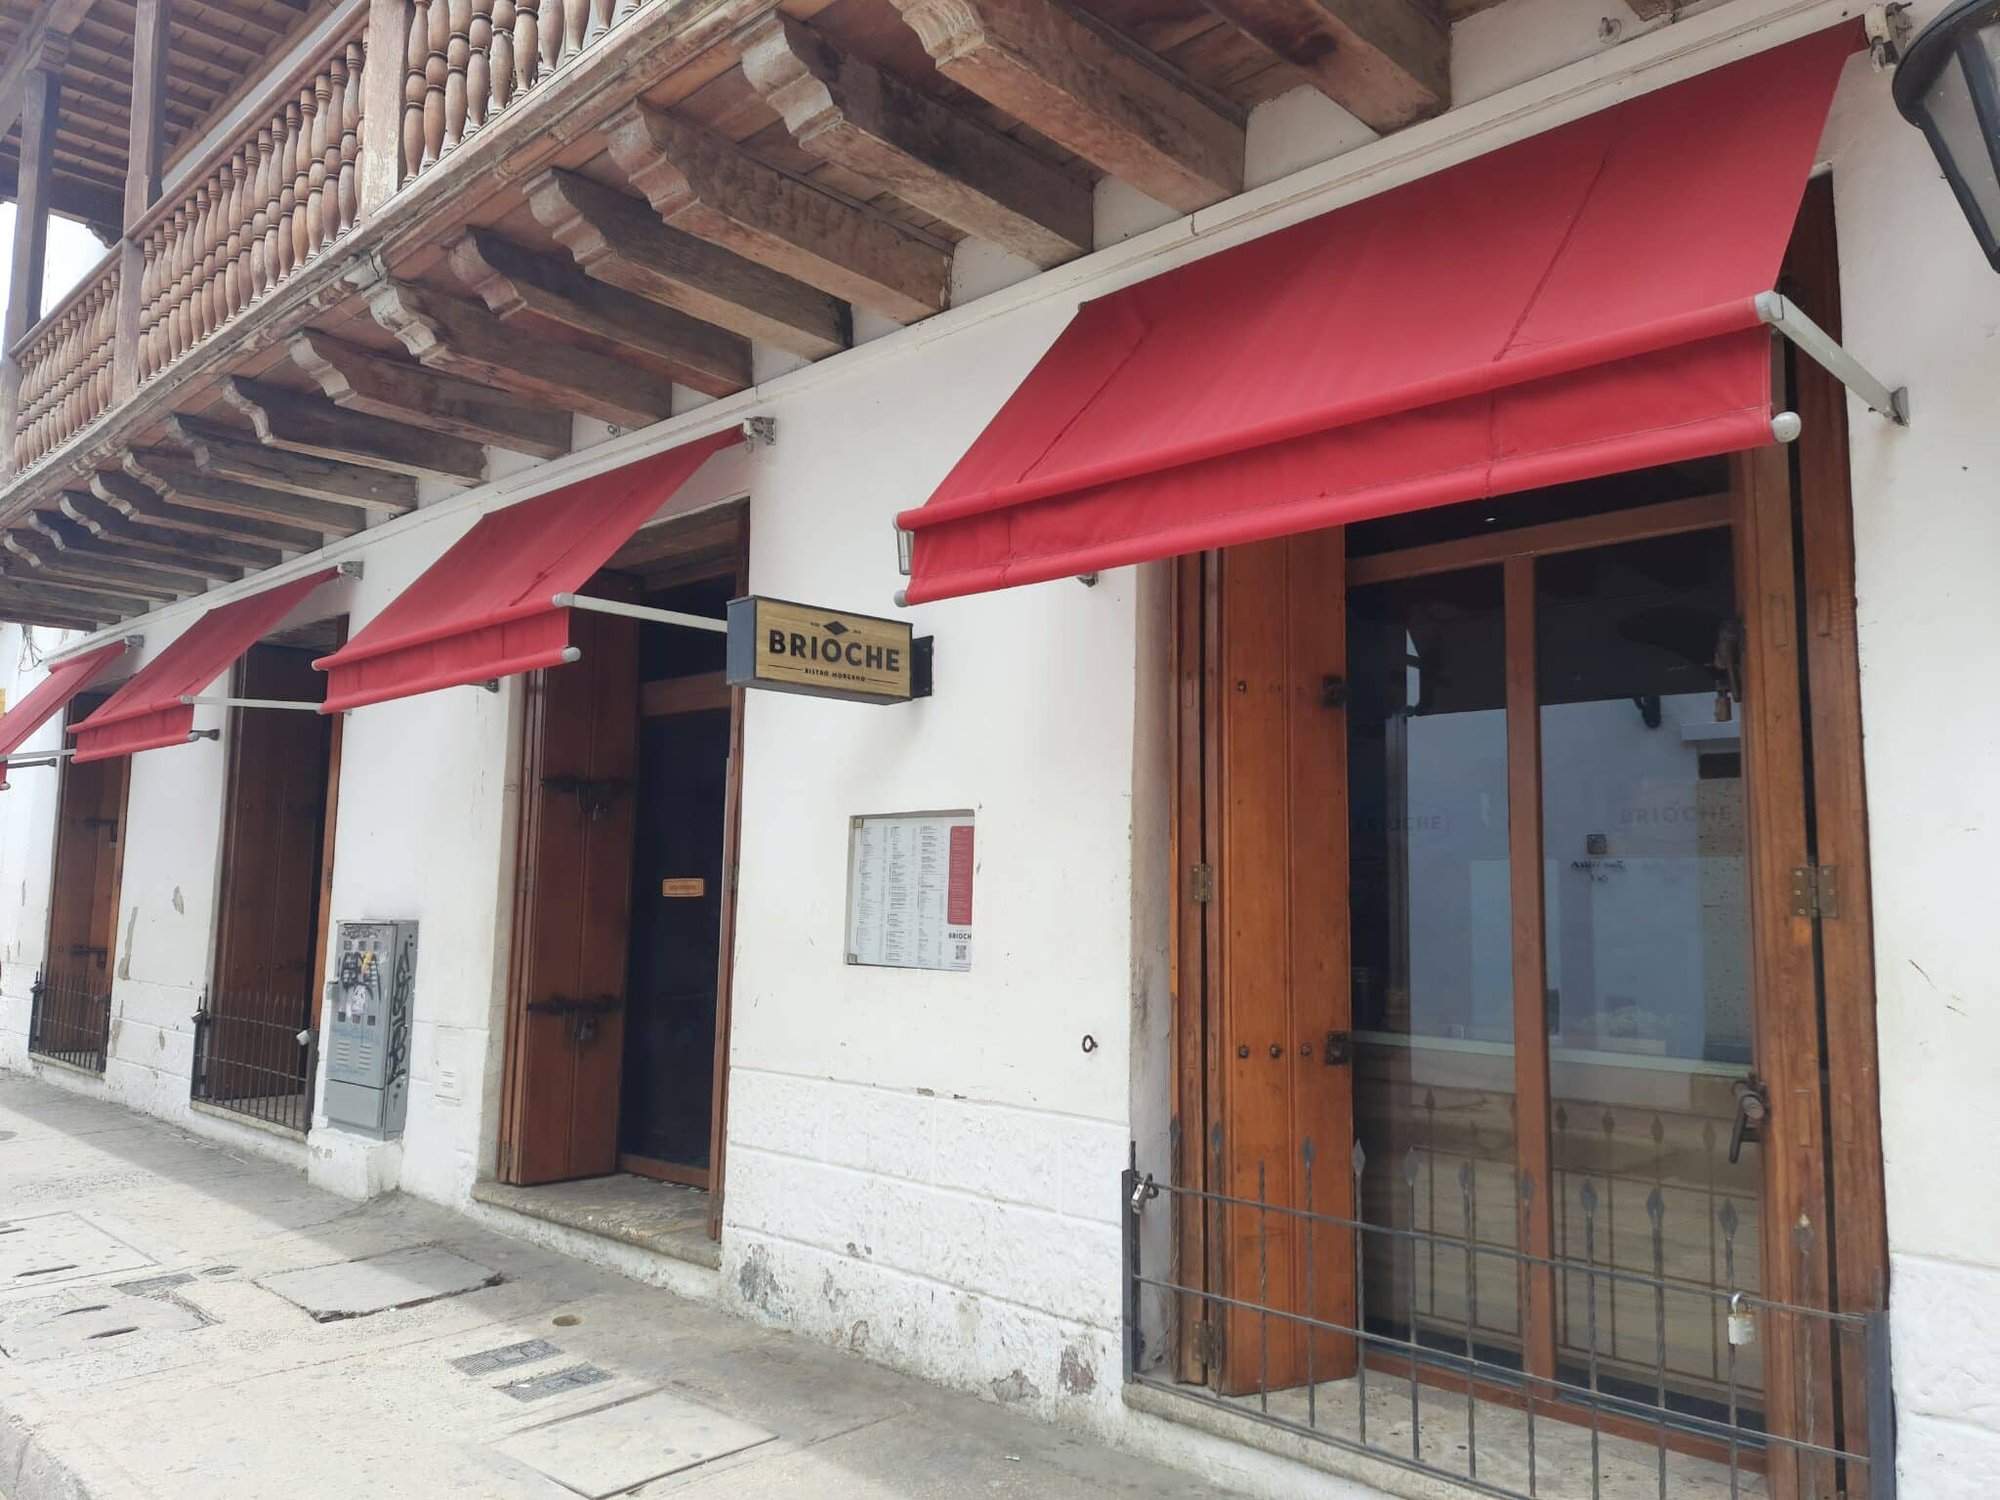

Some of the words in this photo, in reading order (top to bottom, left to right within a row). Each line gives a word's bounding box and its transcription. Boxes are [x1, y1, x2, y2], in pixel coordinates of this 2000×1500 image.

[769, 629, 900, 673] BRIOCHE
[804, 668, 829, 677] BISTRO
[1620, 804, 1731, 825] BRIOCHE
